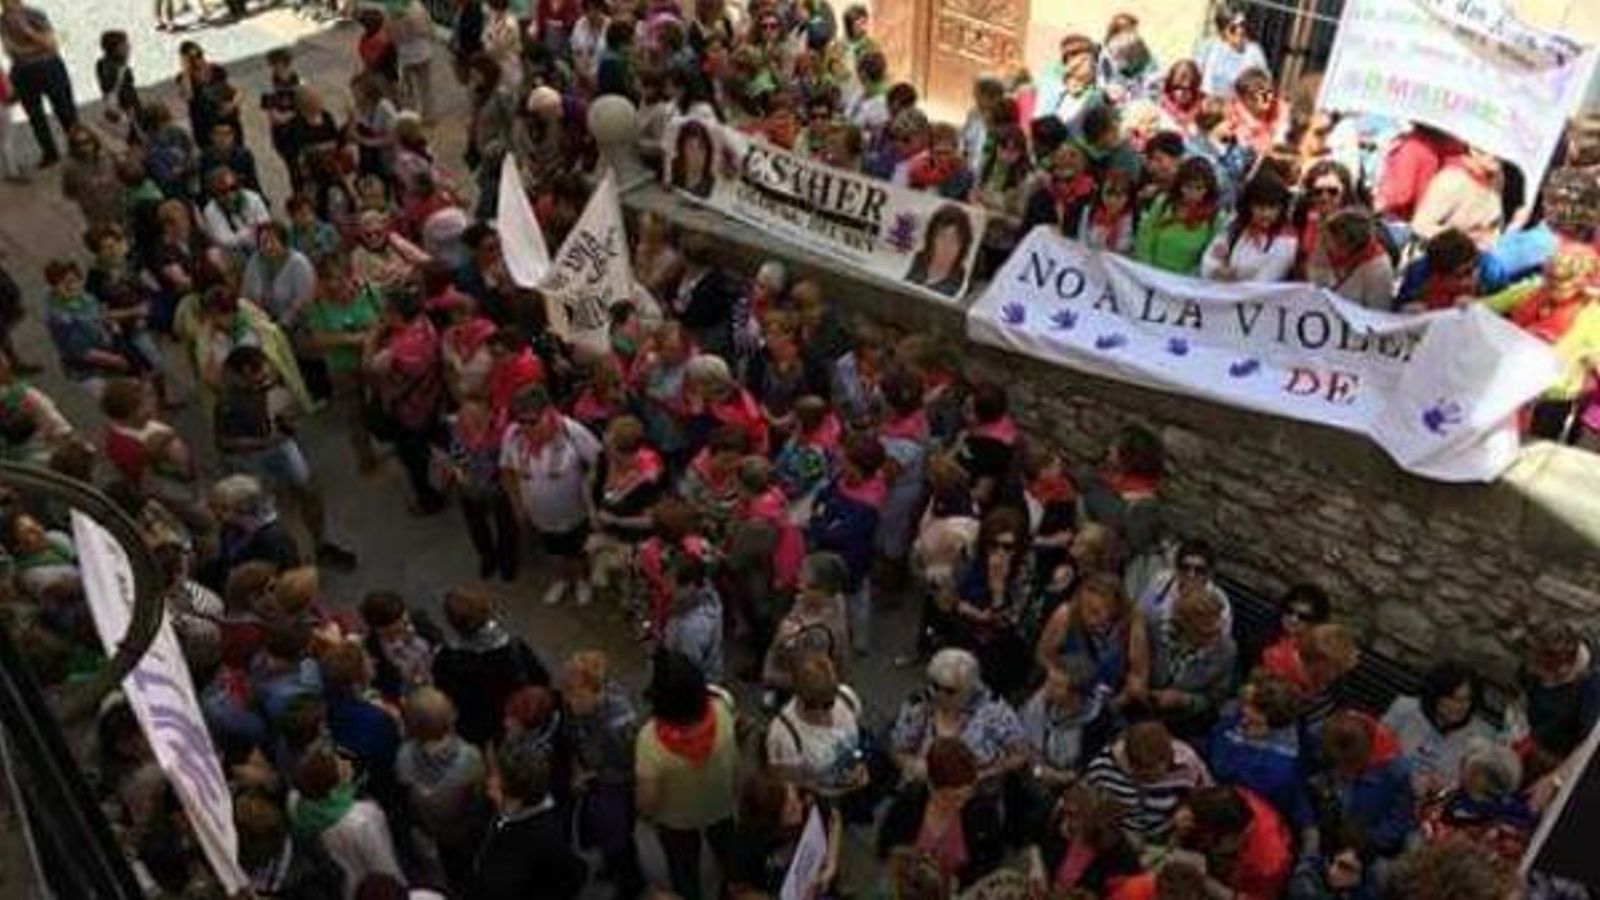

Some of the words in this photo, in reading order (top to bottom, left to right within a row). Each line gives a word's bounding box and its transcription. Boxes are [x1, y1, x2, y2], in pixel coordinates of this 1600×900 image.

[743, 149, 888, 221] ESTHER
[1018, 252, 1085, 300] NO
[1093, 286, 1121, 316] A
[1139, 291, 1202, 330] LA
[1283, 367, 1358, 404] DE
